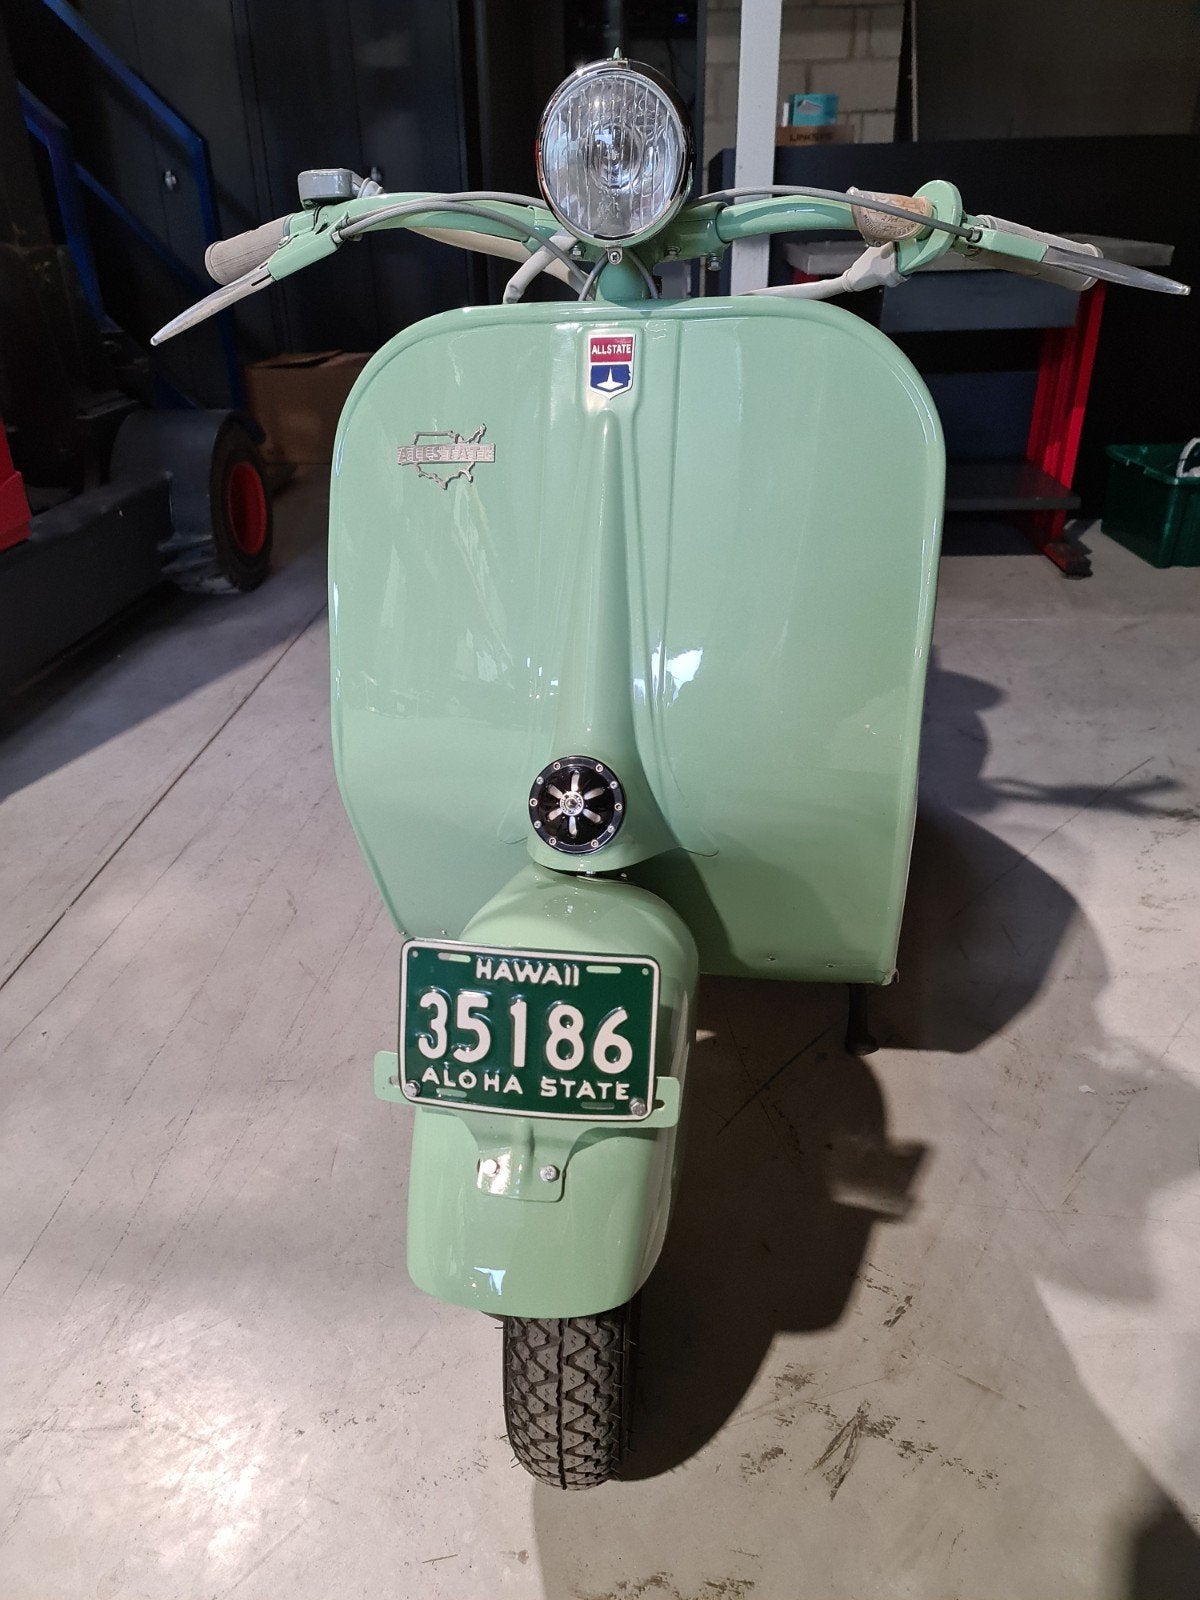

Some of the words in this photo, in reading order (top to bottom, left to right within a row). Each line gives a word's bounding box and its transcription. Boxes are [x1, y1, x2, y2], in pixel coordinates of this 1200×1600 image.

[592, 344, 631, 355] ALLSTATE
[476, 957, 579, 987] HAWAII
[418, 990, 633, 1074] 35186
[422, 1066, 523, 1095] ALOHA
[540, 1077, 630, 1100] STATE
